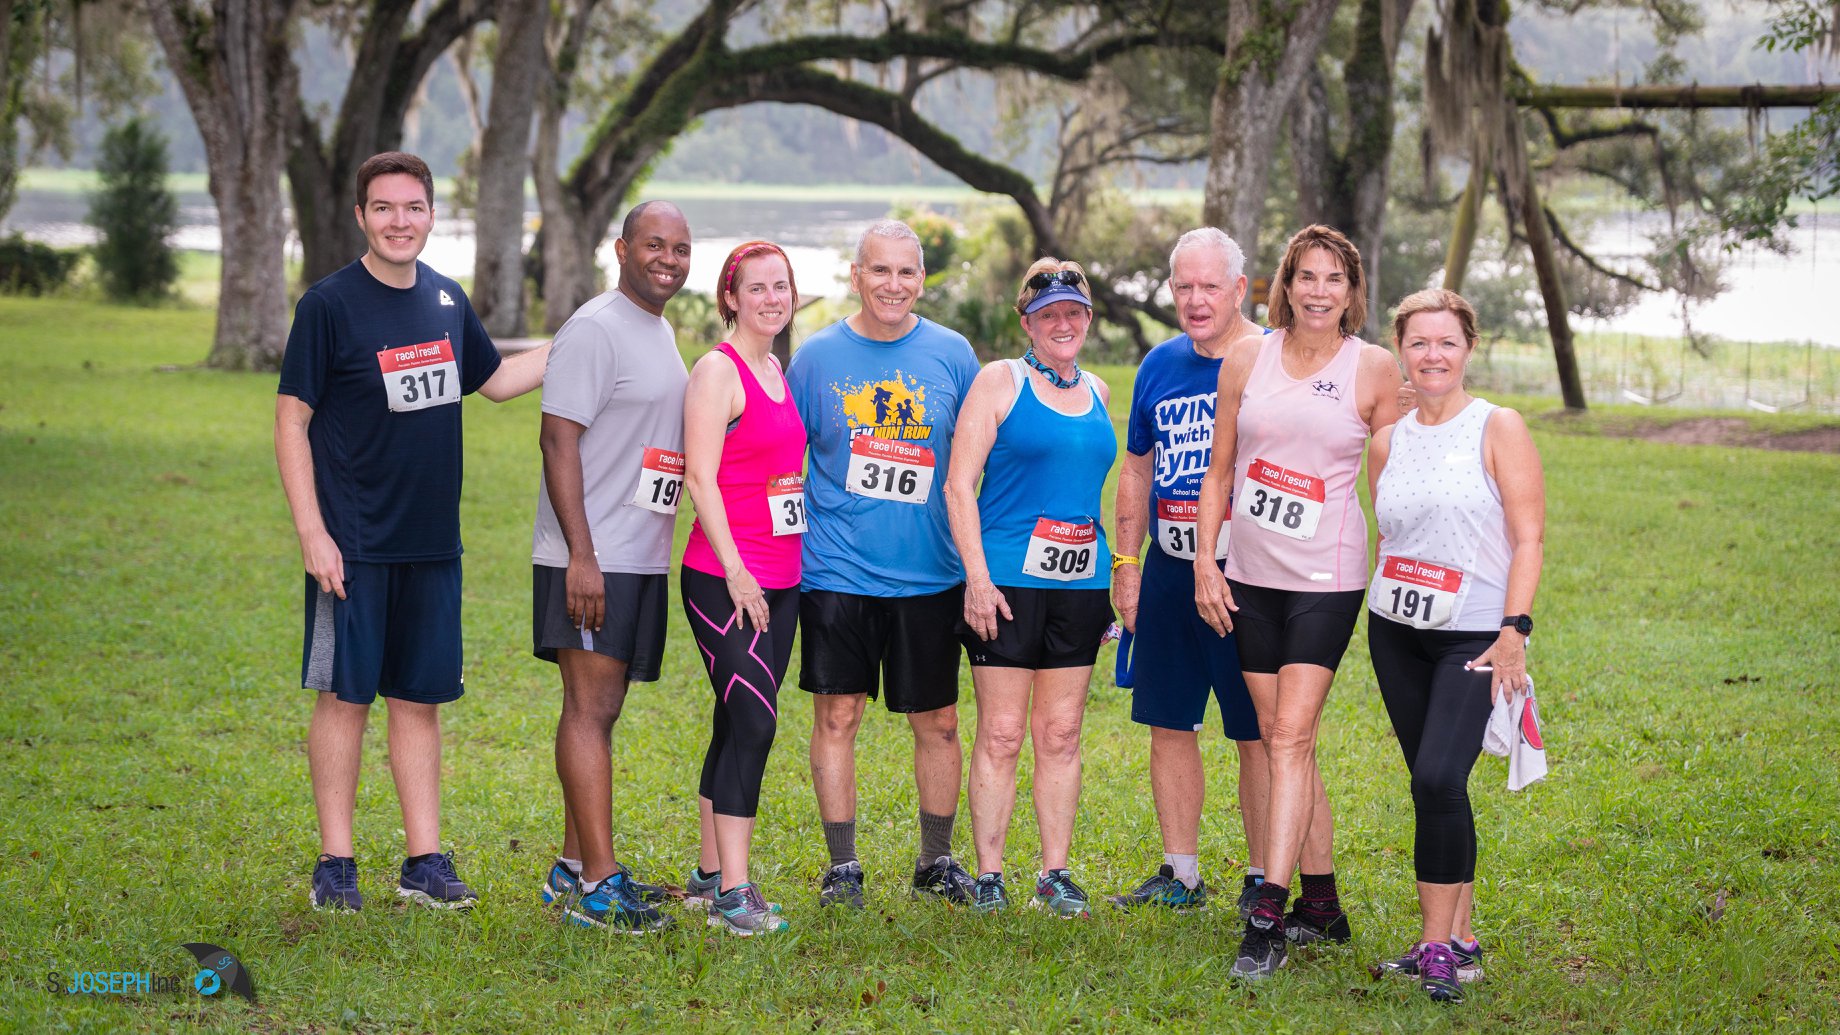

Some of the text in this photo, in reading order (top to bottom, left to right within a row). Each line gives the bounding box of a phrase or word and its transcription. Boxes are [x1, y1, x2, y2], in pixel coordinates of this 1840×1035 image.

[395, 345, 441, 362] race result
[400, 369, 446, 403] 317
[1159, 397, 1217, 426] WIN
[873, 426, 901, 440] NUN
[902, 425, 932, 440] RUN
[1173, 424, 1210, 446] with
[659, 454, 676, 466] race
[868, 440, 890, 453] race
[894, 445, 921, 458] result
[861, 462, 918, 496] 316
[1261, 466, 1280, 480] race
[1283, 474, 1312, 490] result
[1172, 488, 1191, 496] School
[783, 498, 807, 527] 31
[1166, 504, 1184, 514] race
[1249, 488, 1305, 530] 318
[1050, 525, 1071, 536] race
[1168, 526, 1196, 554] 31
[1040, 546, 1090, 575] 309
[1396, 562, 1414, 573] race
[1417, 565, 1446, 582] result
[1391, 586, 1436, 622] 191
